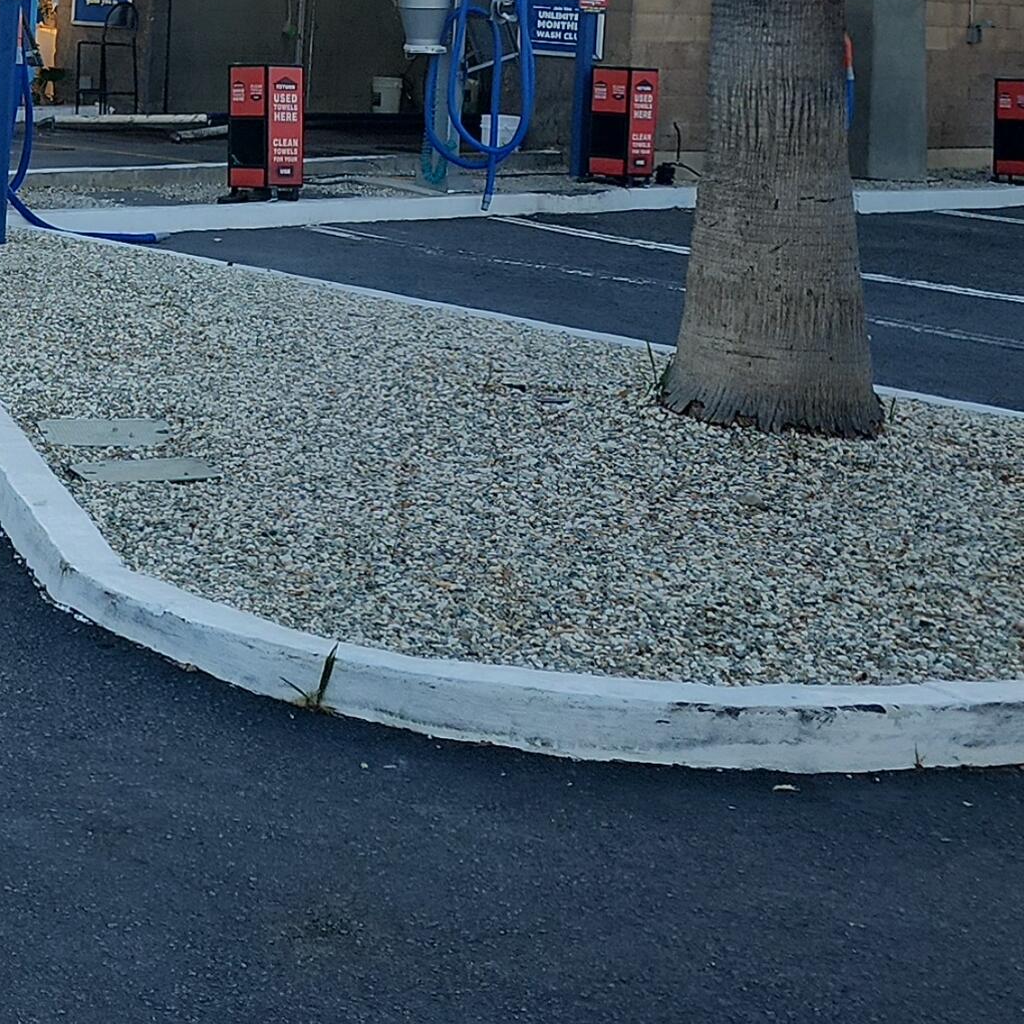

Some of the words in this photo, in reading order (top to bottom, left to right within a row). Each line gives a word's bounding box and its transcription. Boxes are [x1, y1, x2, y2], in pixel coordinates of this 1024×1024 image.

[536, 30, 562, 39] WASH
[273, 93, 298, 103] USED
[634, 94, 653, 103] USED
[273, 112, 298, 122] HERE
[633, 110, 652, 119] HERE
[632, 133, 651, 141] CLEAN
[272, 138, 299, 147] CLEAN
